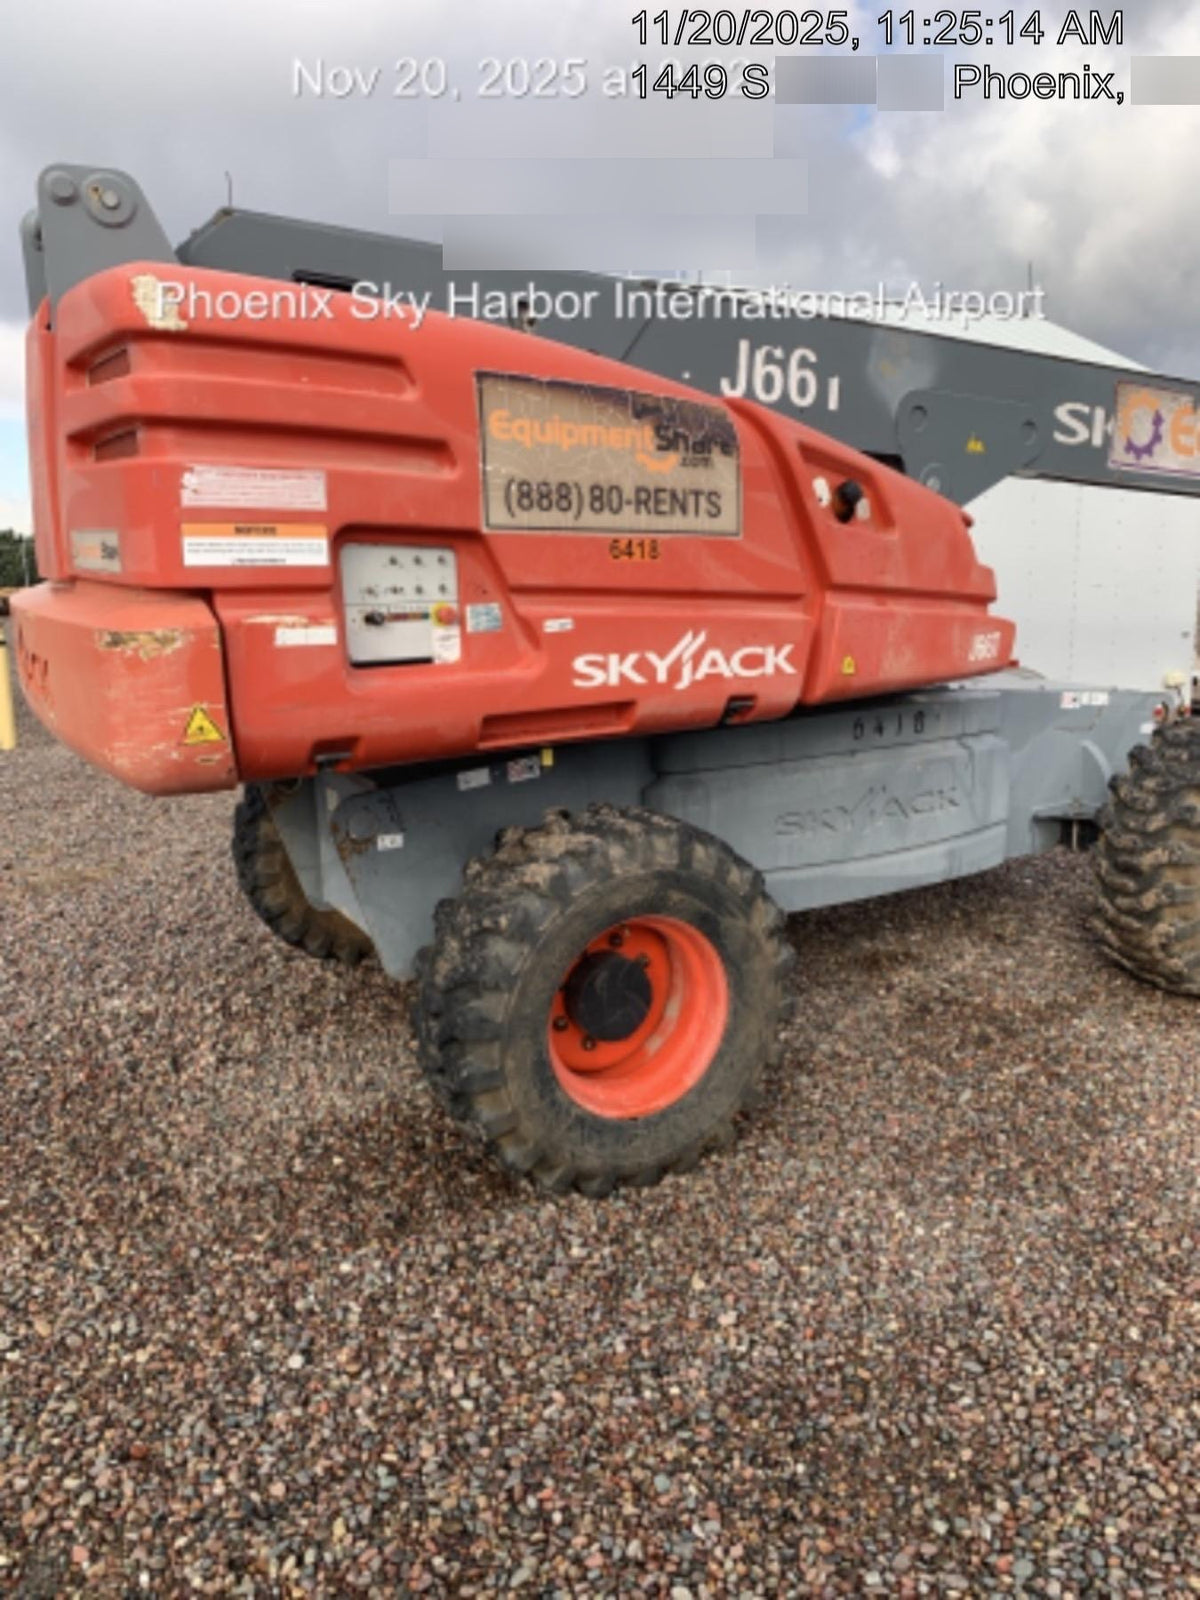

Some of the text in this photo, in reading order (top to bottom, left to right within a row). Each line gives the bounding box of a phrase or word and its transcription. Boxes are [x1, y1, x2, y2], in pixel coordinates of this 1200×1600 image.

[503, 477, 723, 521] (888) 80-RENTS
[608, 538, 661, 561] 6418
[571, 628, 797, 691] SKYJACK
